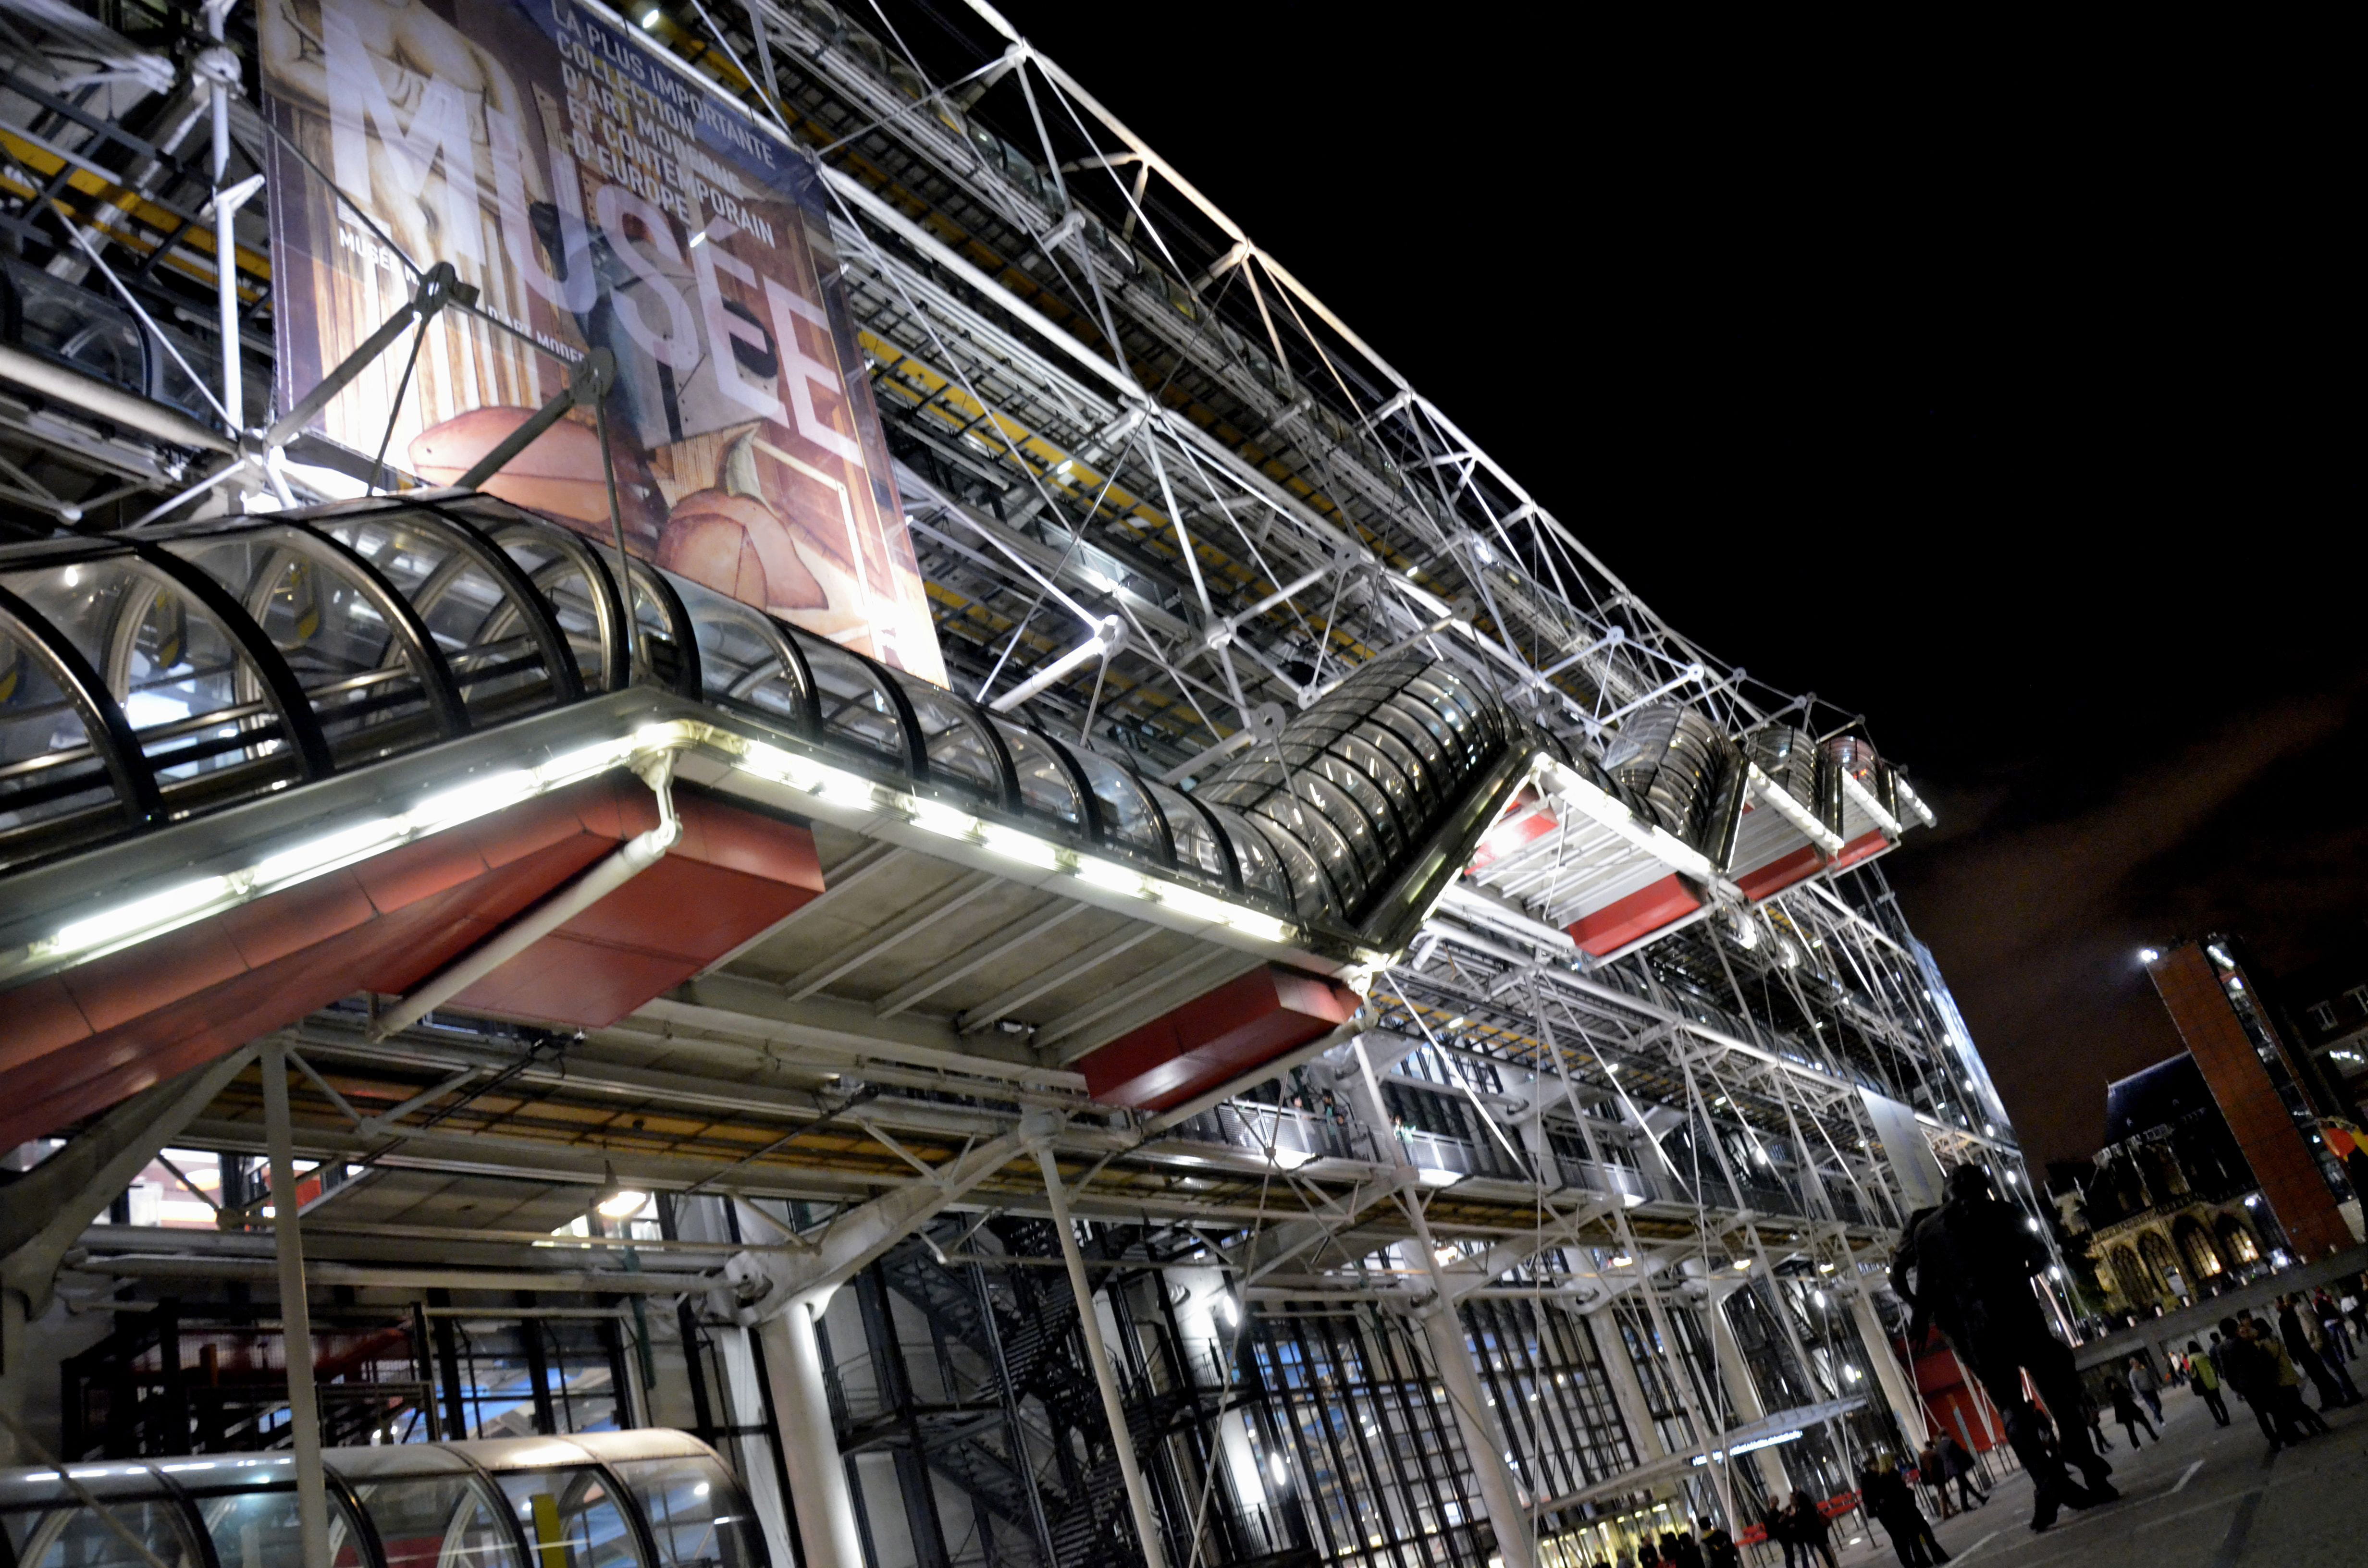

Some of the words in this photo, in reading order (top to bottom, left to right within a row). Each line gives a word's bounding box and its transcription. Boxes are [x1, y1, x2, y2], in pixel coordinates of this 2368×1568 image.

[551, 0, 582, 38] LA
[586, 22, 645, 81] PLUS
[650, 65, 776, 170] IMPORTANTE
[556, 30, 695, 142] COLLECTION
[561, 60, 629, 125] D'ART
[635, 110, 744, 202] MODERNE
[321, 0, 864, 469] MUSÉE
[567, 92, 594, 134] ET
[602, 119, 776, 249] CONTEMPORAIN
[572, 128, 691, 225] D'EUROPE
